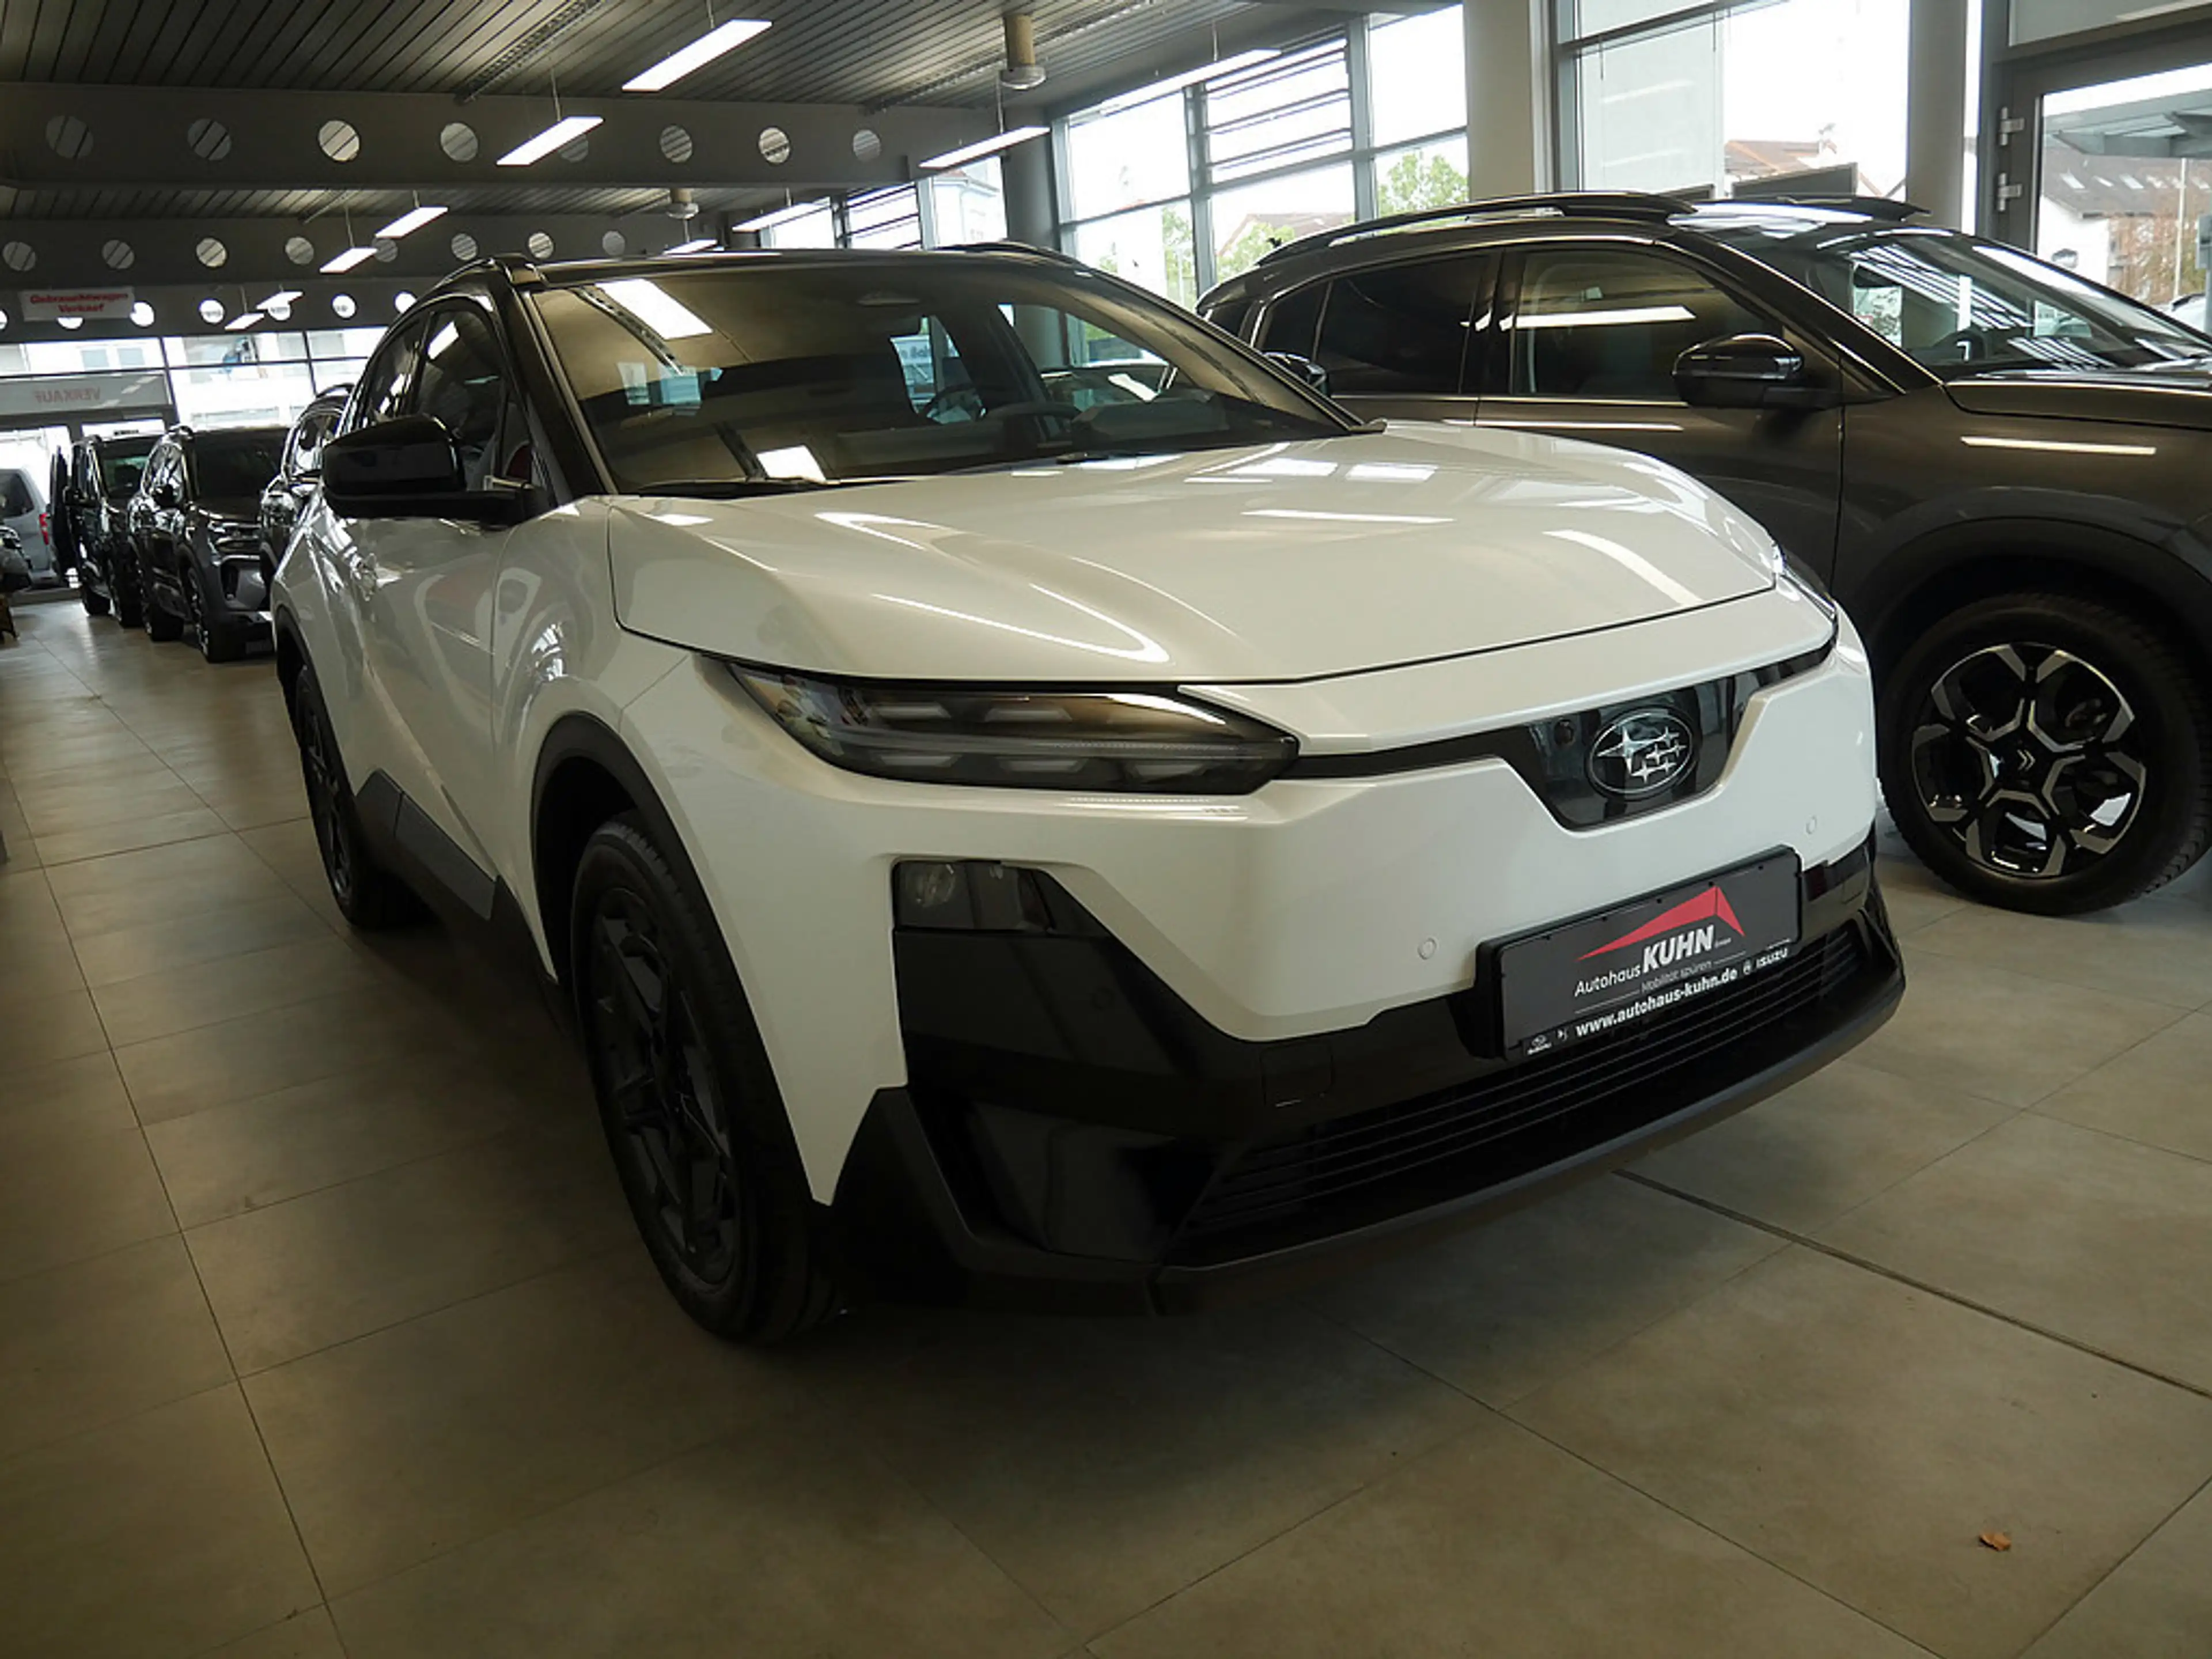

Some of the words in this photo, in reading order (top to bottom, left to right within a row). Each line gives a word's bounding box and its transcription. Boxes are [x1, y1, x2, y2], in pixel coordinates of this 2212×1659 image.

[1574, 964, 1641, 997] Autohaus
[1642, 925, 1715, 974] KUHN
[1575, 967, 1737, 1037] www.autohaus-kuhn.de
